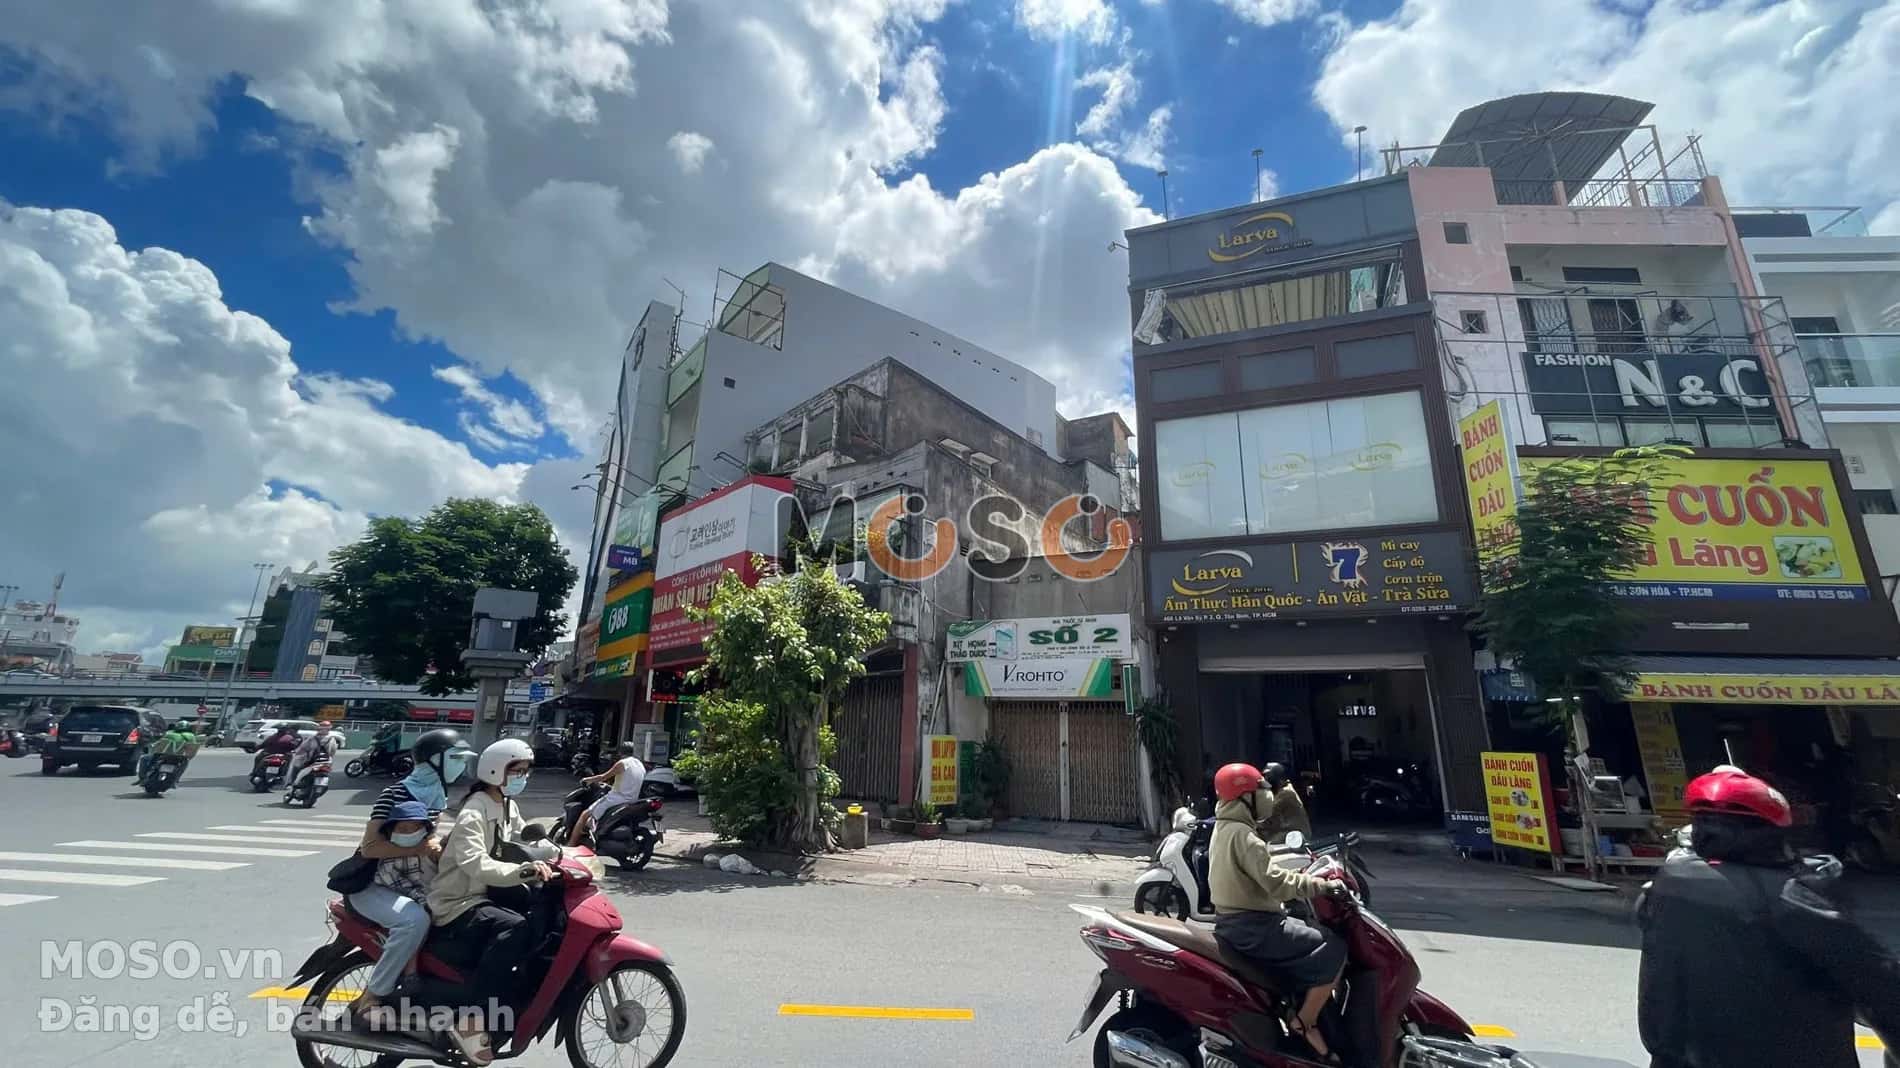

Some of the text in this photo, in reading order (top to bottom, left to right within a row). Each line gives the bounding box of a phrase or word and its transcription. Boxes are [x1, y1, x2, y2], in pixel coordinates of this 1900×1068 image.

[1217, 228, 1278, 249] Larva
[1534, 354, 1612, 367] FASHION
[1463, 414, 1499, 450] BÁNH
[1469, 444, 1505, 483] CUỐN
[1666, 466, 1829, 528] CUỐN
[1400, 541, 1420, 552] cay
[622, 556, 638, 566] MB
[1383, 556, 1407, 570] Cấp
[1668, 537, 1769, 576] Lăng
[1184, 563, 1243, 581] Larva
[1384, 572, 1443, 585] Cơm trộn
[1190, 596, 1228, 612] Thực
[1231, 594, 1261, 609] Hàn
[1264, 592, 1303, 609] Quốc
[1382, 586, 1412, 602] Trà
[1416, 585, 1449, 601] Sữa
[1028, 624, 1118, 645] SỐ 2
[968, 640, 987, 650] HỌNG
[1641, 680, 1713, 698] BÁNH
[1720, 680, 1793, 699] CUỐN
[1863, 683, 1900, 700] LĂ
[1484, 757, 1535, 772] BÁNH CUỐN
